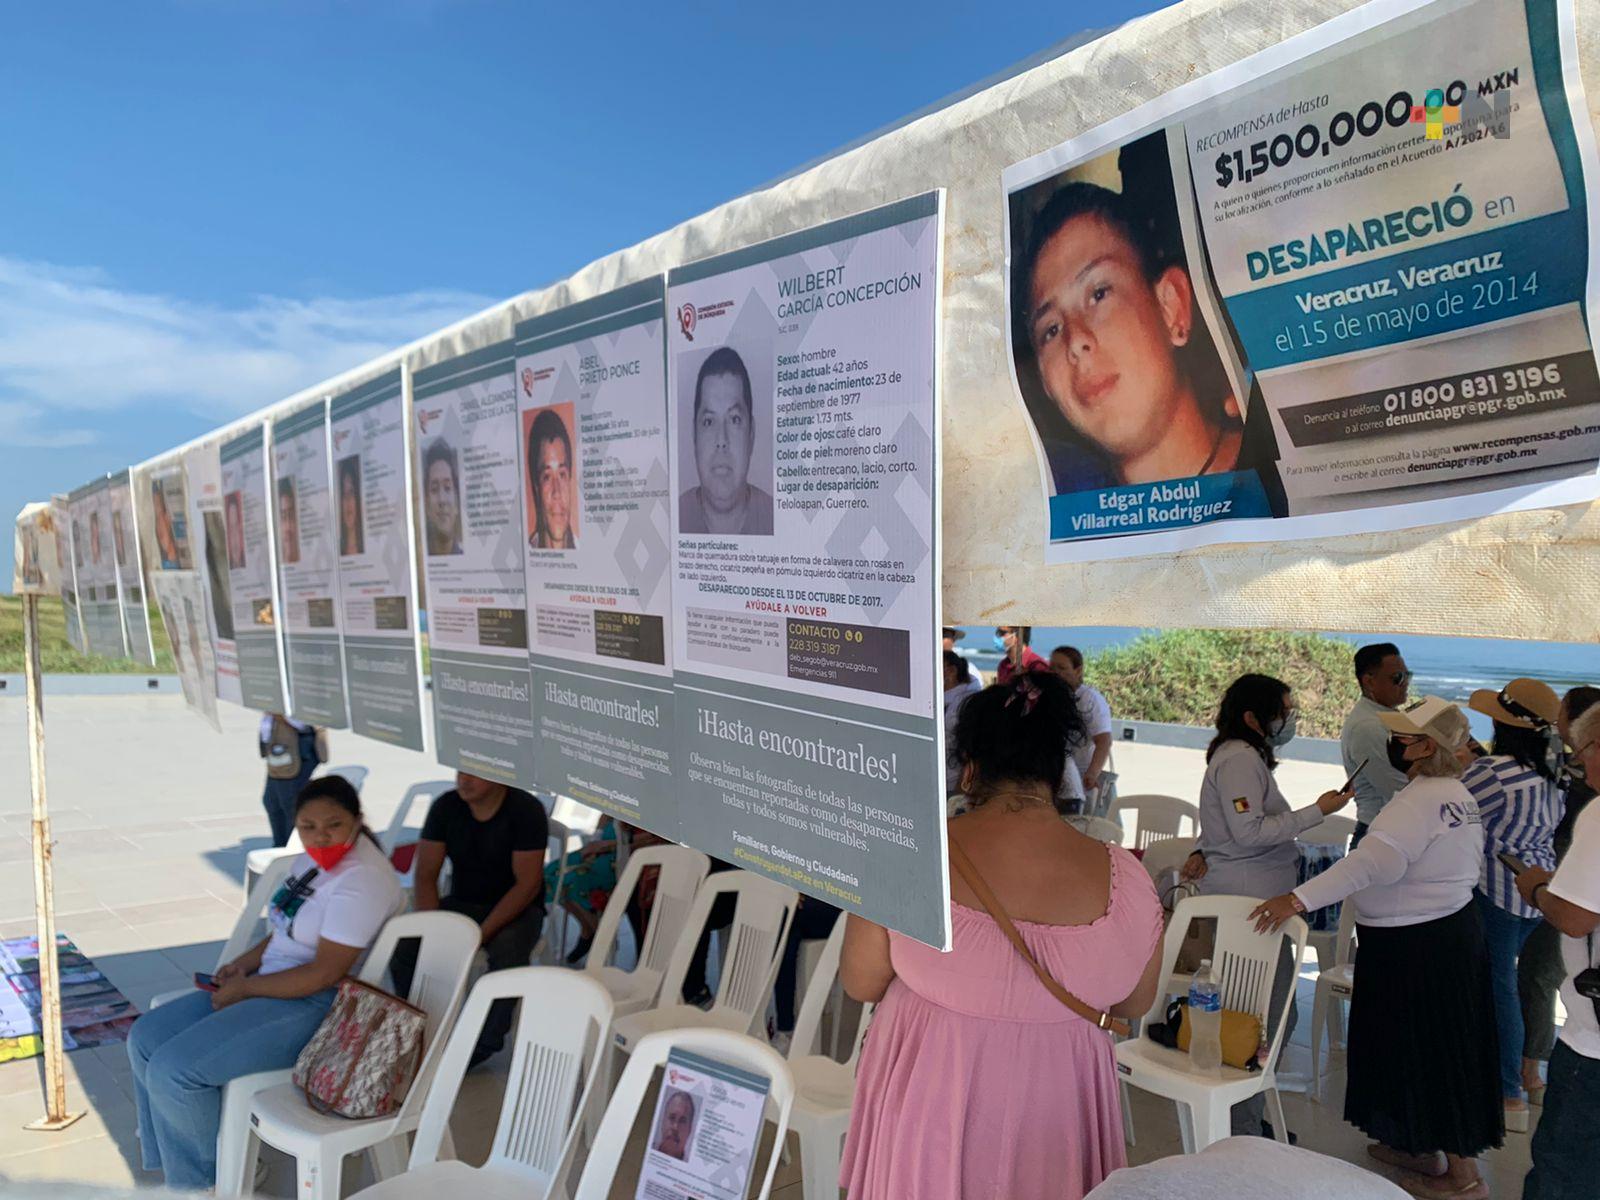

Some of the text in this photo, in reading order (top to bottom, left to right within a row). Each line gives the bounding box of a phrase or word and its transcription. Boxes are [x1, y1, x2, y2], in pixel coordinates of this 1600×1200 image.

[1196, 94, 1329, 153] RECOMPENSA de Hasta
[1215, 67, 1519, 188] $1,500,000.00 MXN
[1275, 184, 1314, 204] conforme
[1334, 164, 1375, 184] señalado
[1377, 162, 1389, 172] en
[1401, 145, 1443, 164] Acuerdo
[1445, 123, 1506, 151] A/202/16
[1221, 195, 1243, 210] quien
[1251, 182, 1282, 201] quienes
[1283, 163, 1340, 190] proporcionen
[1341, 144, 1396, 170] información
[1246, 183, 1515, 282] DESAPARECIÓ en
[777, 265, 846, 298] WILBERT
[1295, 251, 1503, 314] Veracruz, Veracruz
[777, 273, 922, 319] GARCÍA CONCEPCIÓN
[1275, 271, 1538, 352] el 15 de mayo de 2014
[579, 355, 599, 370] ABEL
[777, 348, 837, 366] Sexo: hombre
[579, 360, 641, 385] PRIETO PONCE
[777, 359, 869, 382] Edad actual: 42 años
[777, 371, 902, 398] Fecha de nacimiento: 23 de
[1304, 410, 1340, 425] Denuncia
[1349, 404, 1381, 417] teléfono
[1411, 383, 1455, 408] 800
[1461, 375, 1498, 398] 831
[1503, 363, 1561, 391] 3196
[776, 392, 861, 414] septiembre de 1977
[1360, 387, 1567, 432] correo denunciapgr@pgr.gob.mx
[777, 411, 854, 428] Estatura: 1.73 mts.
[777, 425, 881, 444] Color de ojos: café claro
[777, 442, 897, 461] Color de piel: moreno claro
[1304, 463, 1328, 474] mayor
[1376, 450, 1410, 464] consulta
[1379, 447, 1538, 477] correo denunciapgr@pgr.gob.mx
[776, 461, 917, 478] Cabello: entrecano, lacio, corto.
[776, 478, 879, 495] Lugar de desaparición:
[1099, 481, 1200, 511] Edgar Abdul
[776, 497, 869, 511] Teloloapan, Guerrero.
[1071, 499, 1232, 531] Villarreal Rodríguez
[678, 540, 739, 551] Señas particulares:
[719, 563, 741, 572] cicatriz
[766, 567, 775, 575] en
[776, 566, 801, 577] pómulo
[803, 568, 835, 579] izquierdo
[837, 569, 865, 580] cicatriz
[865, 572, 876, 581] en
[886, 572, 916, 583] cabeza
[739, 553, 904, 570] sobre tatuaje forma de calavera con rosas en
[698, 582, 884, 607] DESAPARECIDO DESDE EL 13 DE OCTUBRE DE 2017.
[745, 599, 827, 617] AYÚDALE VOLVER
[788, 623, 840, 640] CONTACTO
[789, 639, 841, 655] 228 319 3187
[789, 664, 837, 679] Emergencias 911
[544, 681, 660, 728] ¡Hasta encontrarles!
[698, 708, 898, 784] ¡Hasta encontrarles!
[689, 752, 721, 772] Observa
[722, 760, 741, 777] bien
[742, 765, 755, 781] las
[804, 784, 817, 800] de
[819, 789, 846, 809] todas
[848, 795, 863, 814] las
[864, 805, 914, 830] personas
[688, 768, 919, 853] que encuentran reportadas como desaparecidas,
[722, 792, 870, 852] todas todos somos vulnerables.
[771, 845, 805, 867] Gobierno
